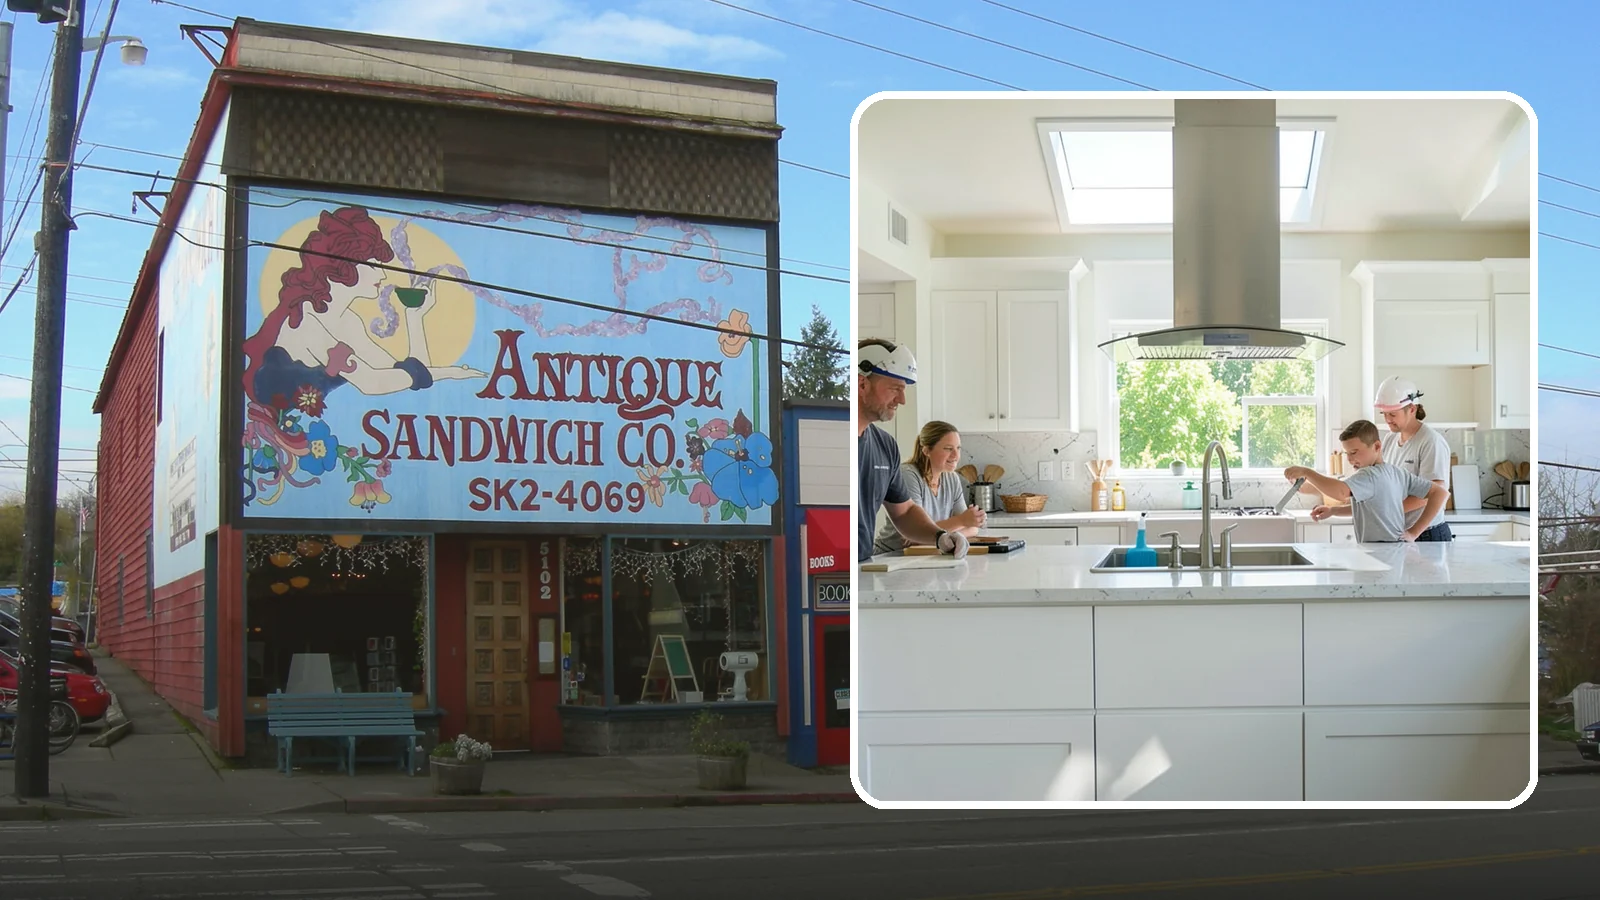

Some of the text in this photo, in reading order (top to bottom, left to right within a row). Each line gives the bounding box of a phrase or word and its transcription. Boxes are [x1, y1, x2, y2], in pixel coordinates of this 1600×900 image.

[476, 329, 723, 421] ANTIQUE
[361, 409, 685, 468] SANDWICH CO.
[469, 477, 645, 512] SK2-4069
[539, 541, 552, 600] 5102
[809, 555, 835, 568] BOOKS
